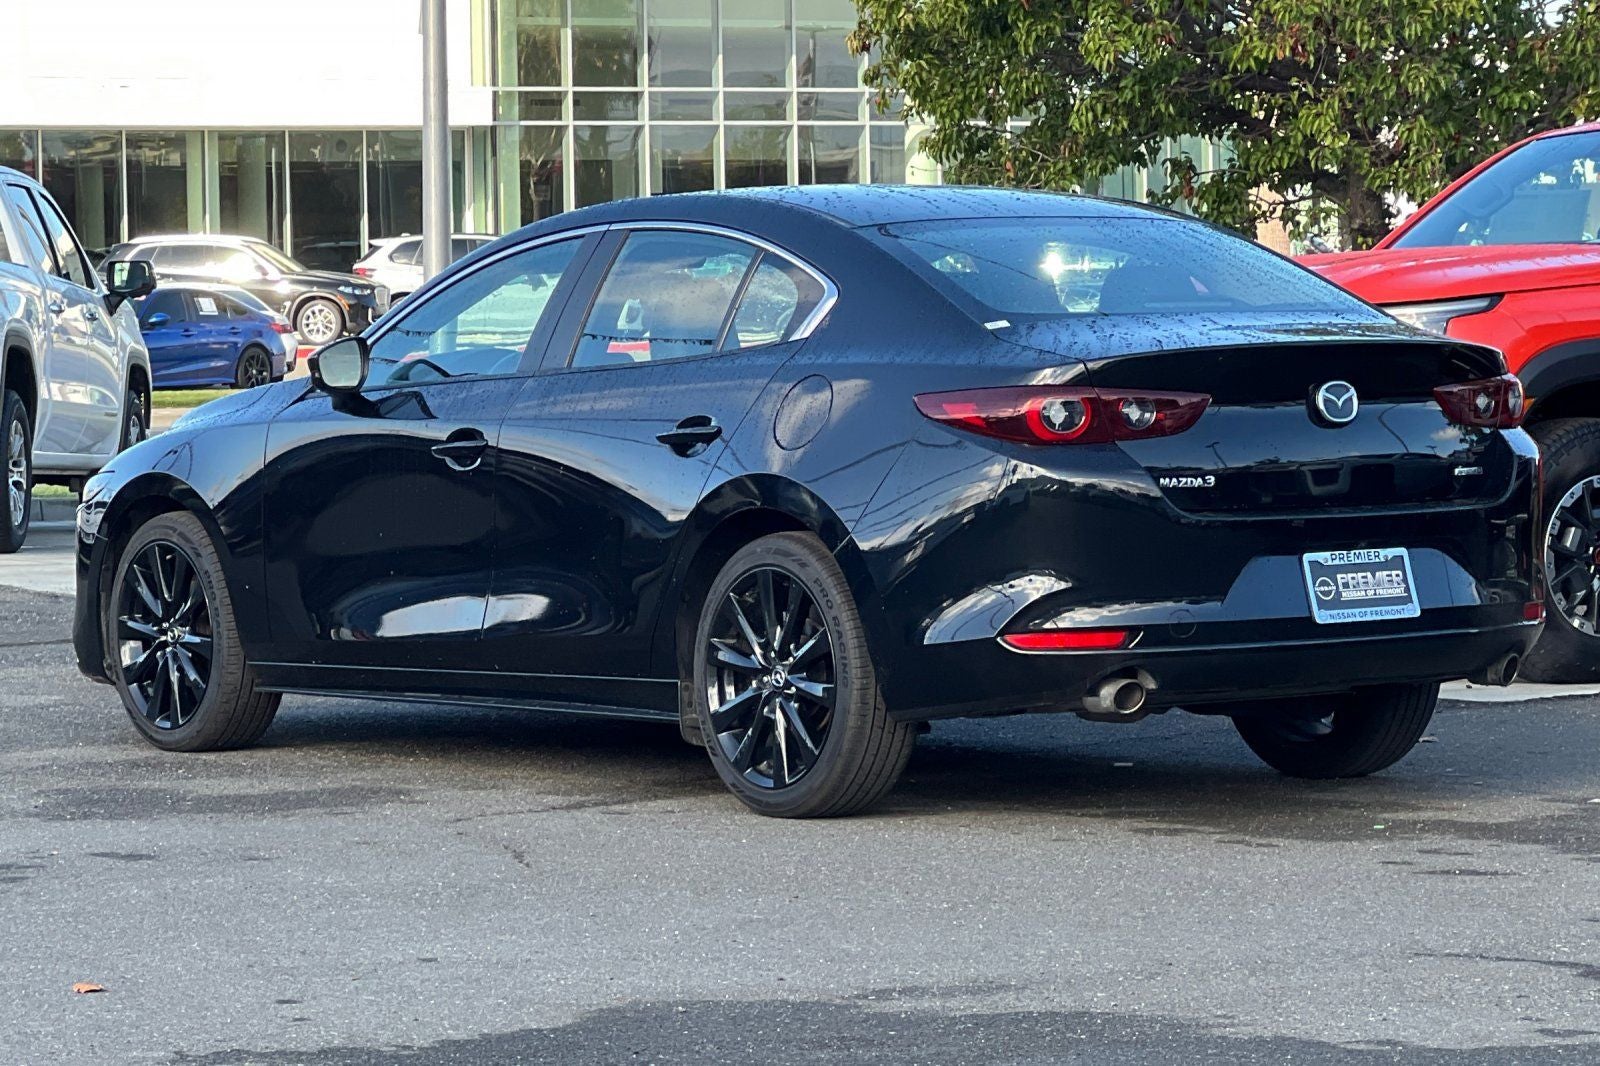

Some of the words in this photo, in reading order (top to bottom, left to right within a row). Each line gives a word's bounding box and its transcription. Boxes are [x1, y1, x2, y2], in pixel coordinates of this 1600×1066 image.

[1159, 475, 1216, 488] MAZDA3
[1330, 551, 1381, 563] PREMIER
[1336, 570, 1405, 590] PREMIER
[1342, 589, 1366, 598] NISSAN
[1367, 588, 1375, 597] OF
[1376, 586, 1405, 596] FREMONT
[1328, 611, 1357, 620] NISSAN
[1359, 610, 1369, 618] OF
[1370, 607, 1406, 617] FREMONT
[813, 576, 834, 610] PRO
[832, 615, 849, 688] RACING
